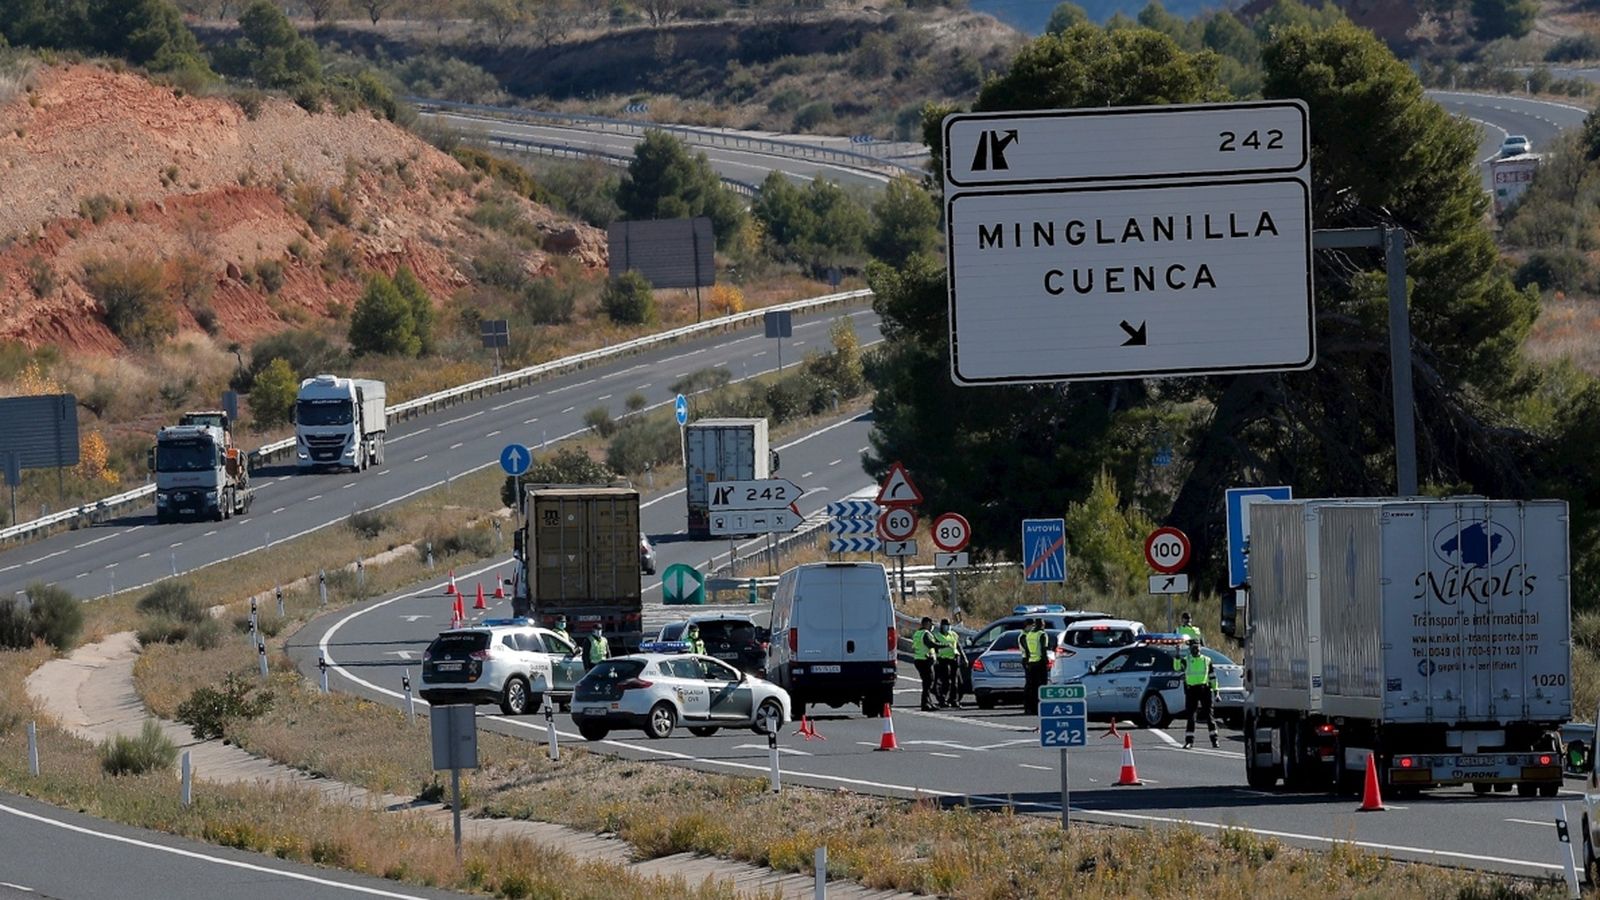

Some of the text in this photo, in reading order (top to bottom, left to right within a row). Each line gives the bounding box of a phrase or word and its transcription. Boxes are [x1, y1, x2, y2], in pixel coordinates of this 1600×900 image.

[1218, 129, 1284, 152] 242
[978, 211, 1279, 250] MINGLANILLA
[1044, 264, 1217, 295] CUENCA
[746, 487, 786, 501] 242
[890, 516, 910, 529] 60
[1026, 523, 1061, 533] AUTOVÍA
[940, 526, 961, 540] 80
[1153, 542, 1181, 558] 100
[1414, 564, 1537, 606] Nikol's
[1531, 673, 1566, 687] 1020
[1046, 687, 1078, 698] E-901
[1052, 704, 1073, 715] A-3
[1056, 720, 1069, 728] km
[1045, 729, 1082, 744] 242
